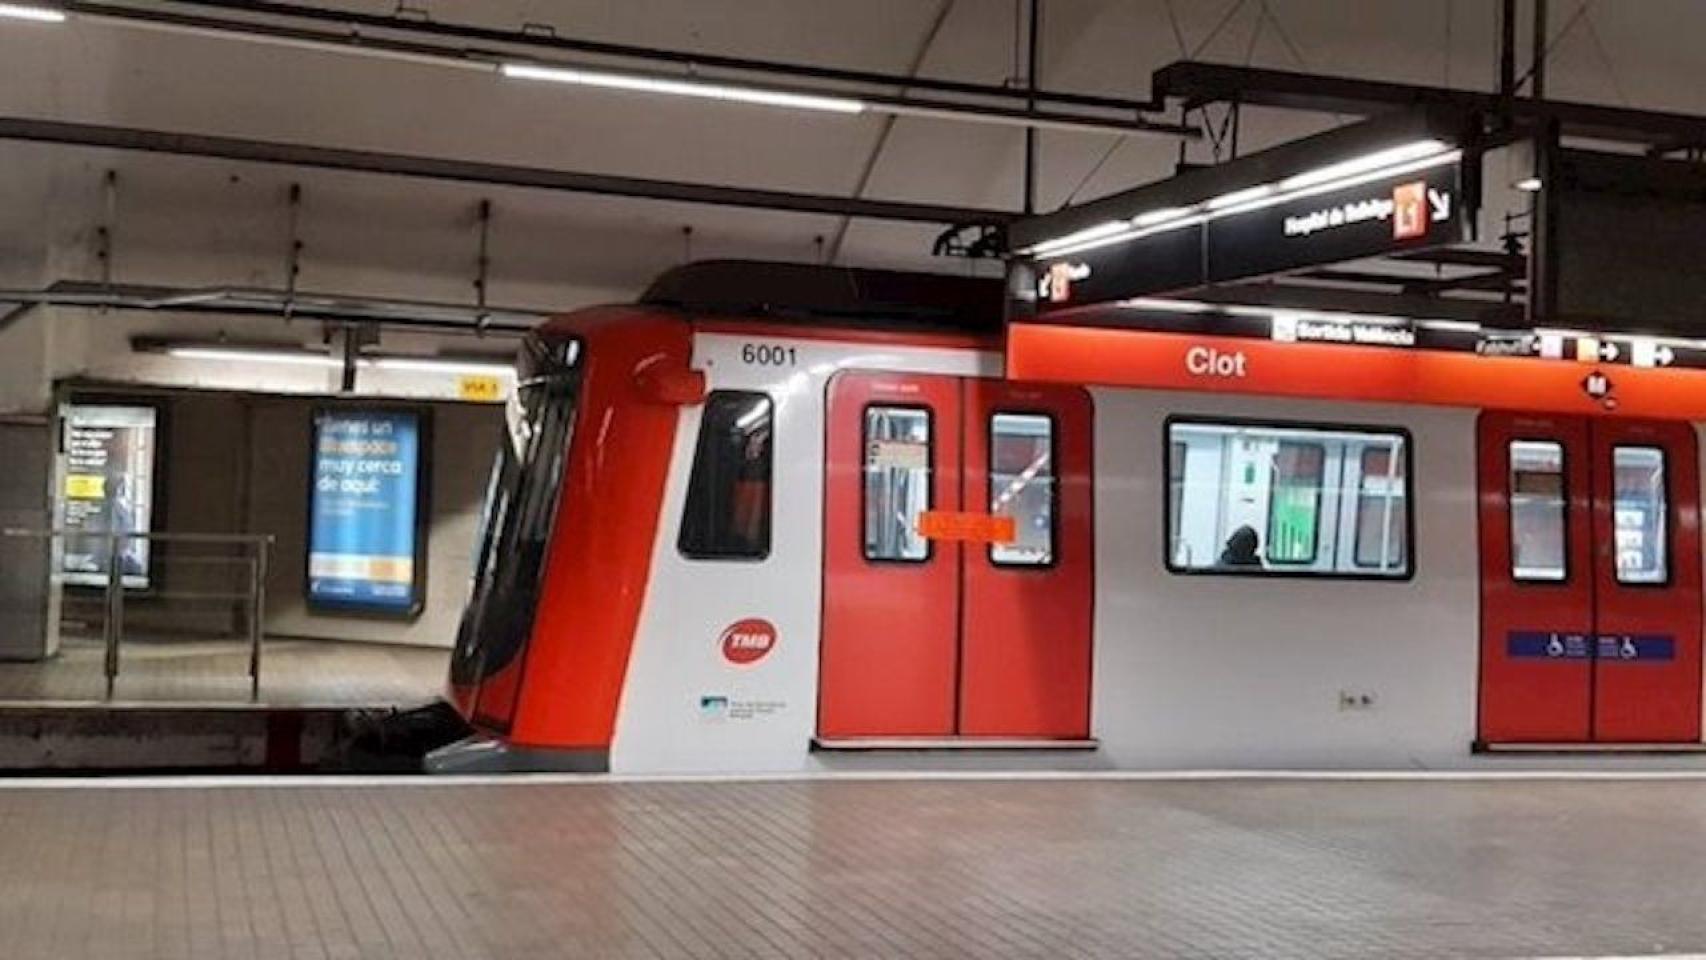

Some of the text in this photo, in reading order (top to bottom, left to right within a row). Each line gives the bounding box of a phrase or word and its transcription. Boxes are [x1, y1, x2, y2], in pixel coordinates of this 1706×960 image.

[742, 343, 797, 366] 6001
[1185, 346, 1247, 377] Clot
[357, 459, 402, 474] cerca
[317, 474, 339, 493] de
[732, 632, 771, 650] TMB
